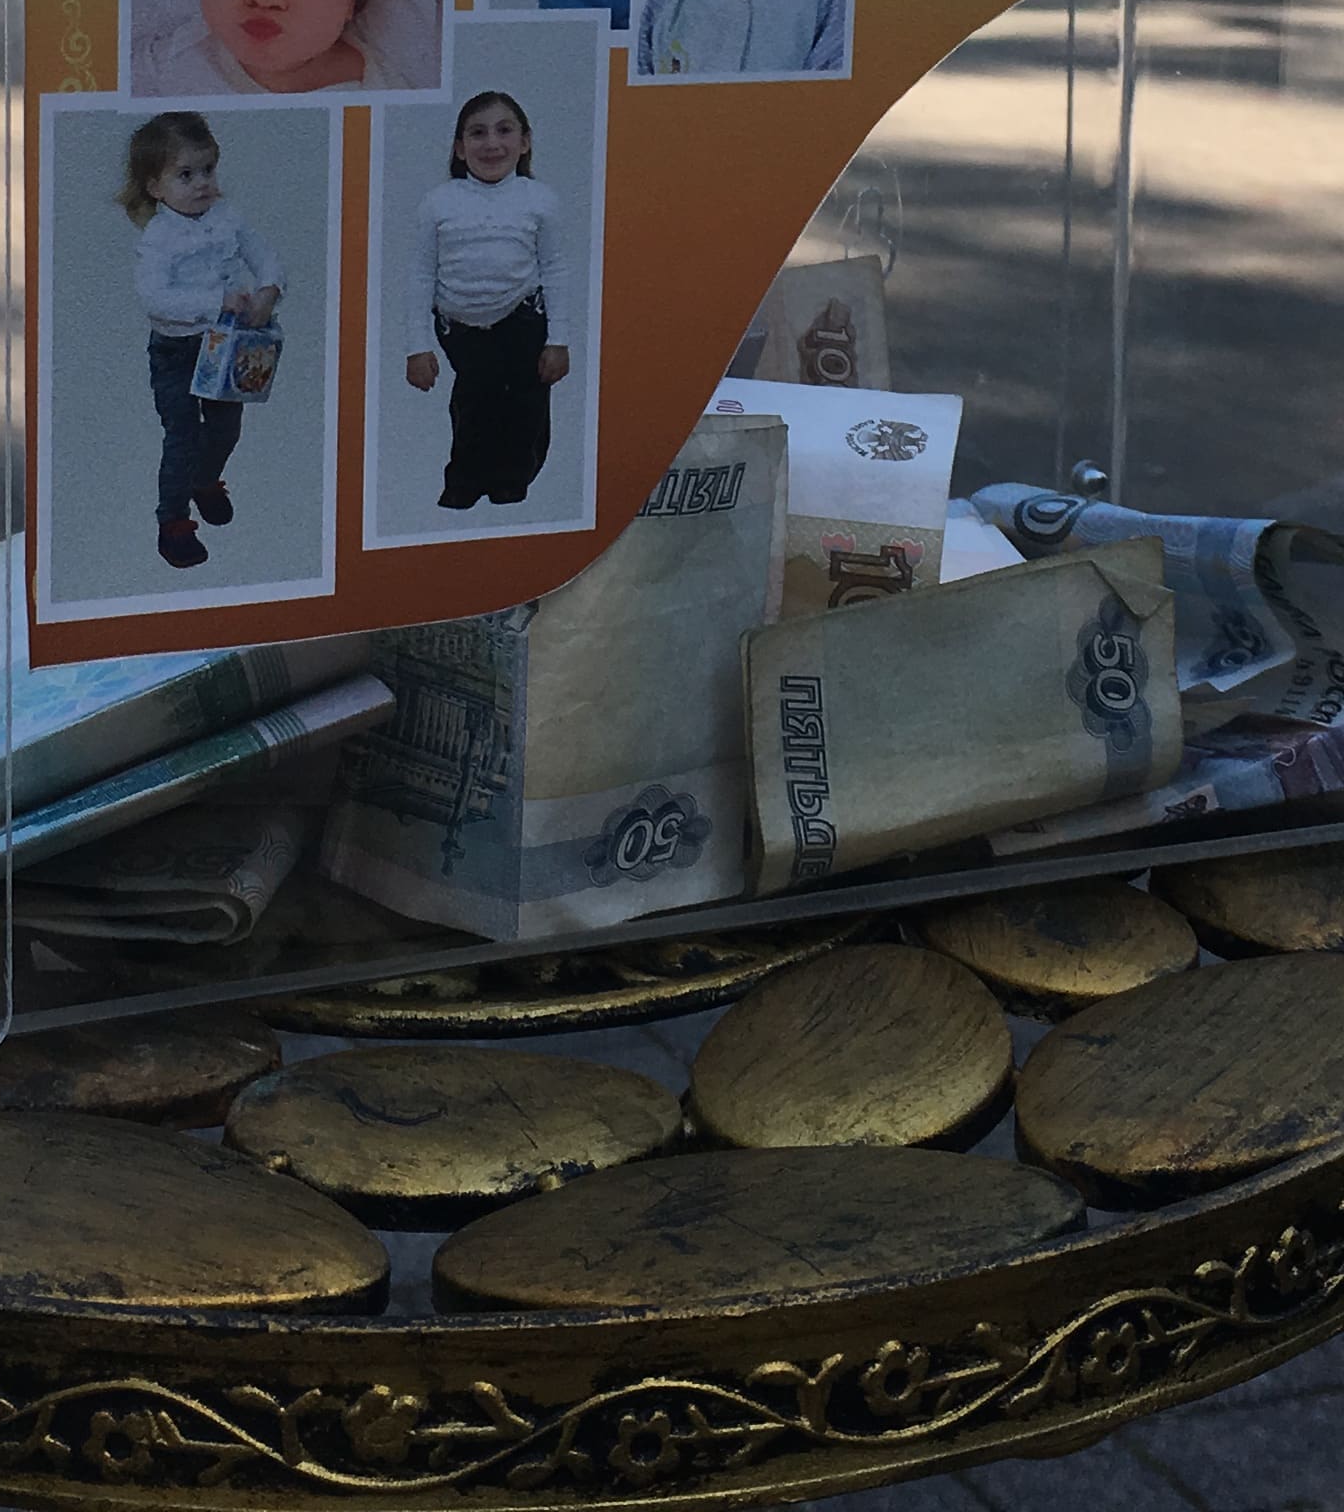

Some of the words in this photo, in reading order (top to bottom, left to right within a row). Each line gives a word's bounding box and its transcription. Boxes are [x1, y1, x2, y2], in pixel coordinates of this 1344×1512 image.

[813, 326, 854, 383] 10
[636, 461, 747, 518] ПЯТ
[1087, 631, 1139, 714] 50
[614, 806, 687, 871] 50
